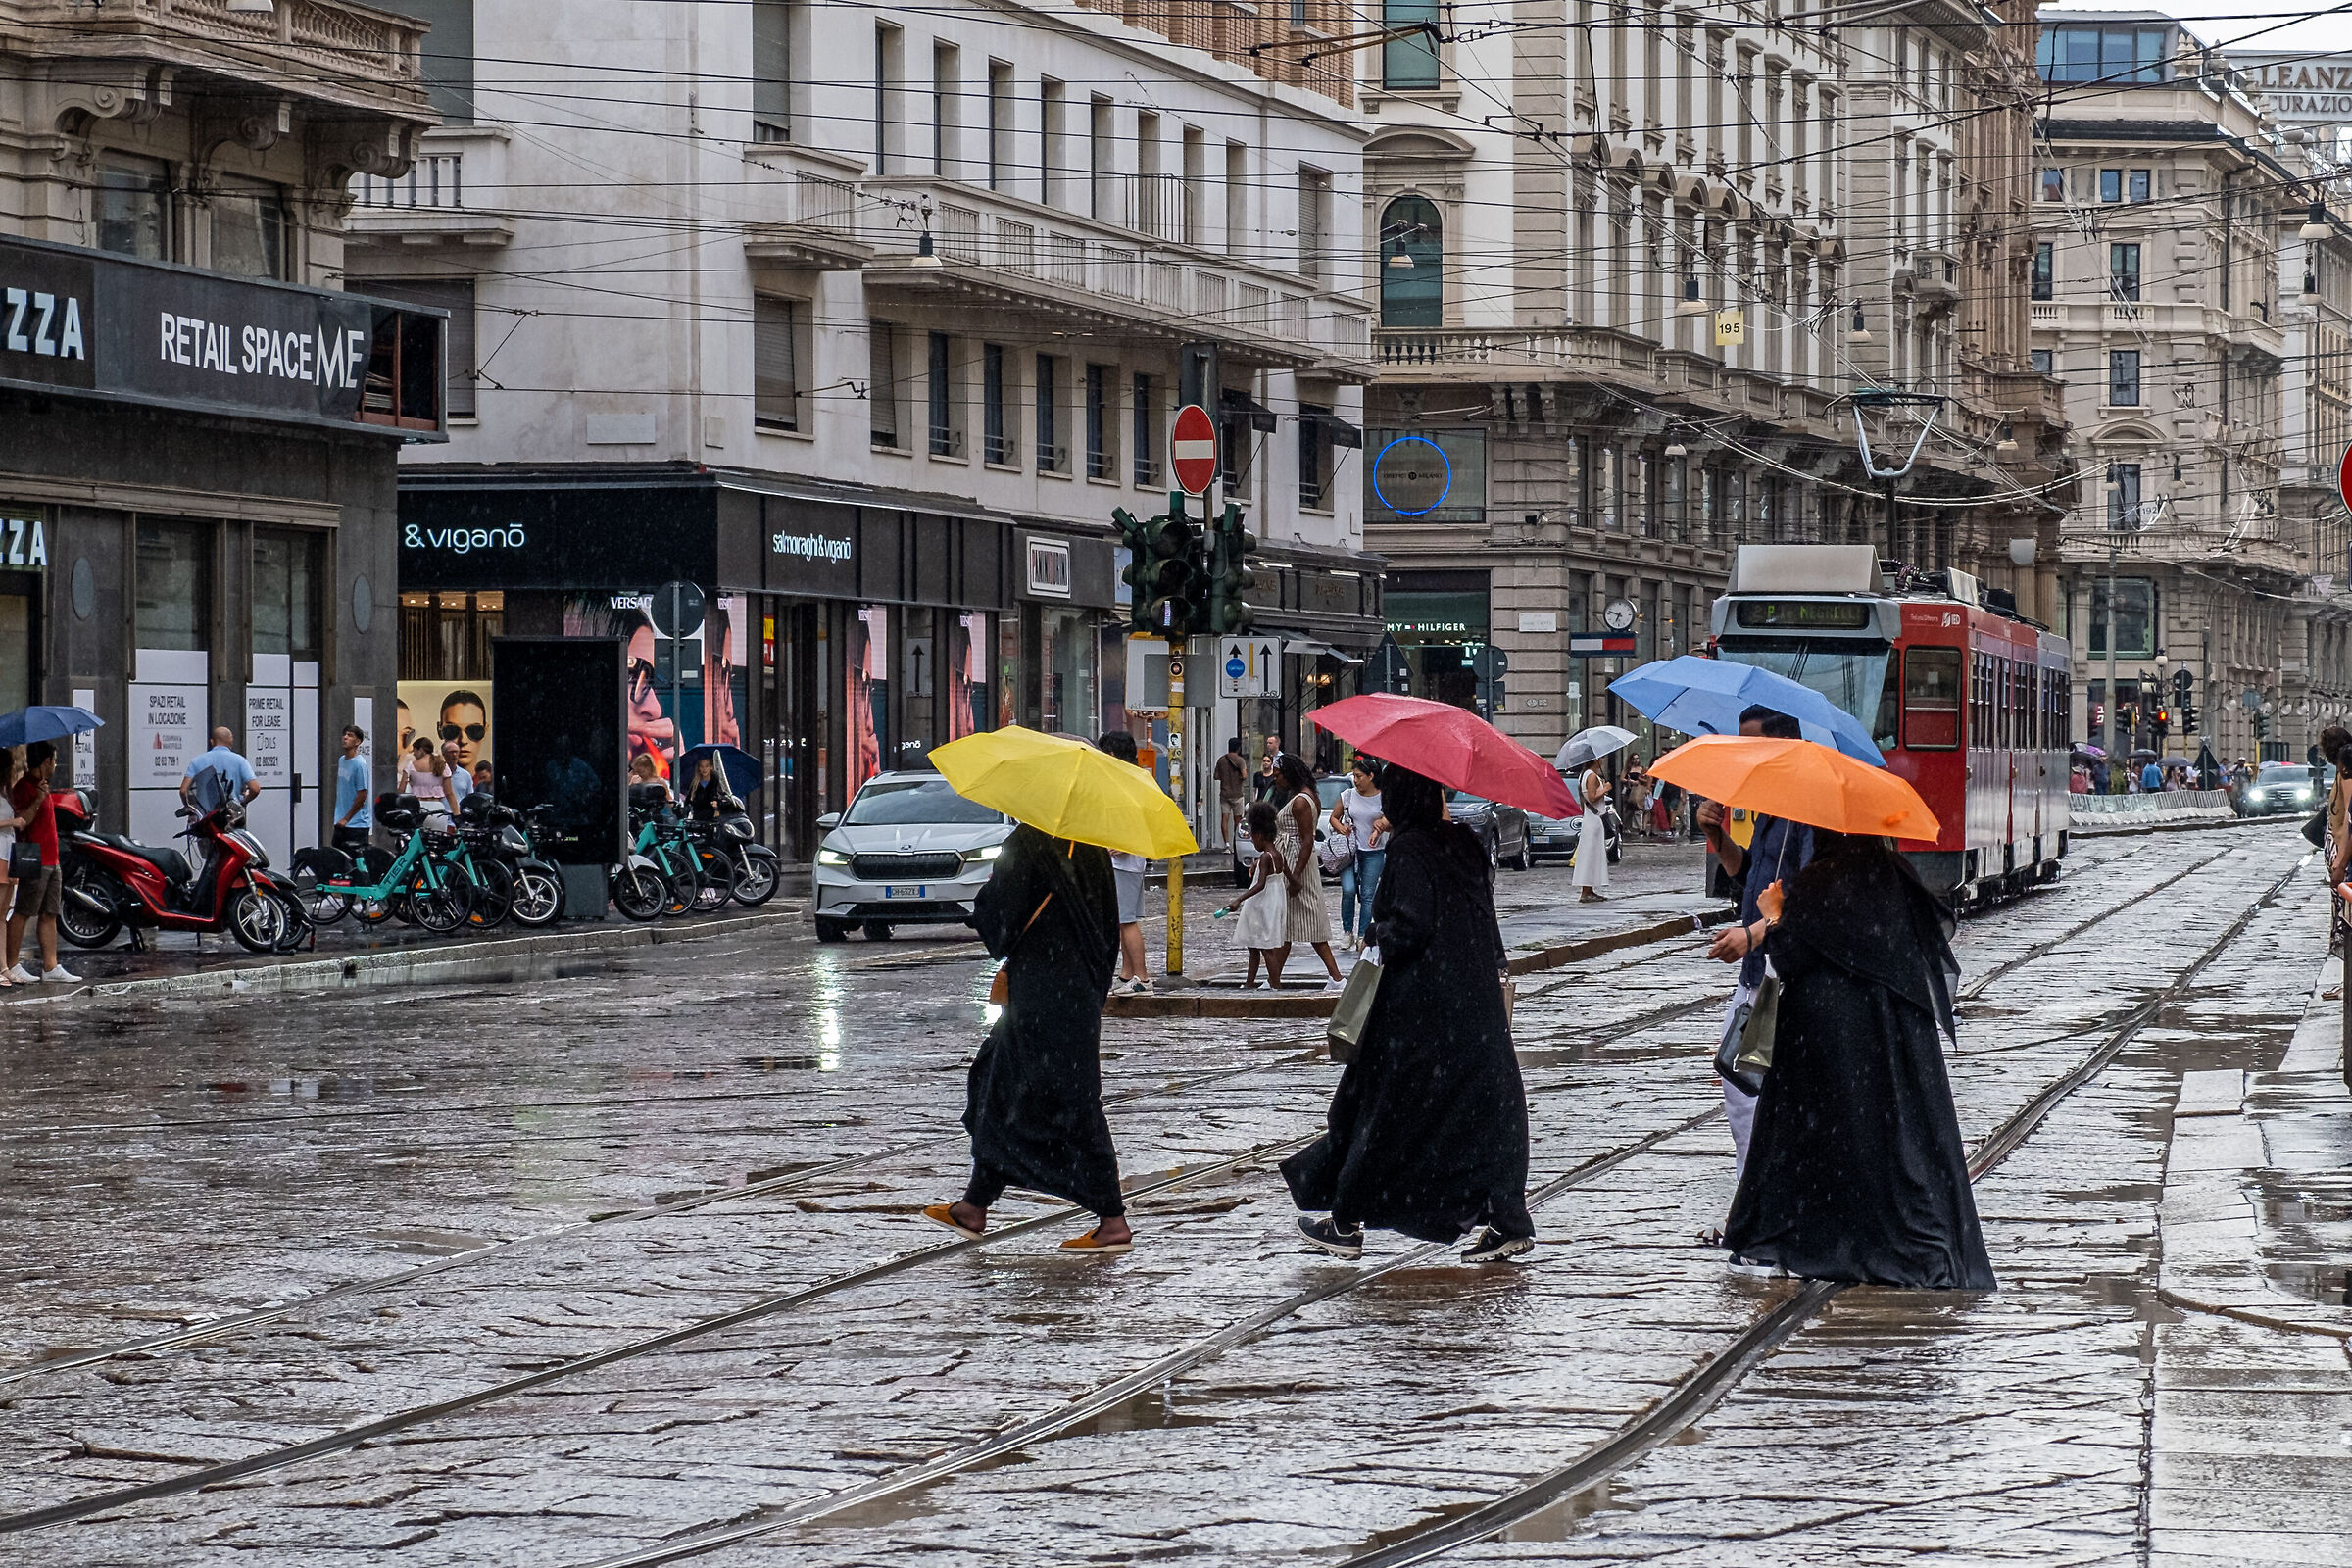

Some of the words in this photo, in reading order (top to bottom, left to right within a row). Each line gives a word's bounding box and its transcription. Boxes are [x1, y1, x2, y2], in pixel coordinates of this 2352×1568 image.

[2258, 65, 2352, 89] LEANZ
[1719, 322, 1740, 334] 195
[161, 312, 238, 374] RETAIL
[241, 324, 313, 381] SPACE
[314, 323, 365, 389] ME
[2142, 506, 2157, 514] 192
[611, 595, 654, 610] VERSAC
[1417, 622, 1466, 632] HILFIGER
[149, 695, 166, 708] SPAZI
[167, 695, 186, 708] RETAIL
[248, 697, 266, 710] PRIME
[266, 697, 284, 710] RETAIL
[148, 712, 155, 725] IN
[155, 712, 186, 725] LOCAZIONE
[252, 715, 264, 727] FOR
[264, 715, 281, 727] LEASE
[383, 858, 408, 885] TIER
